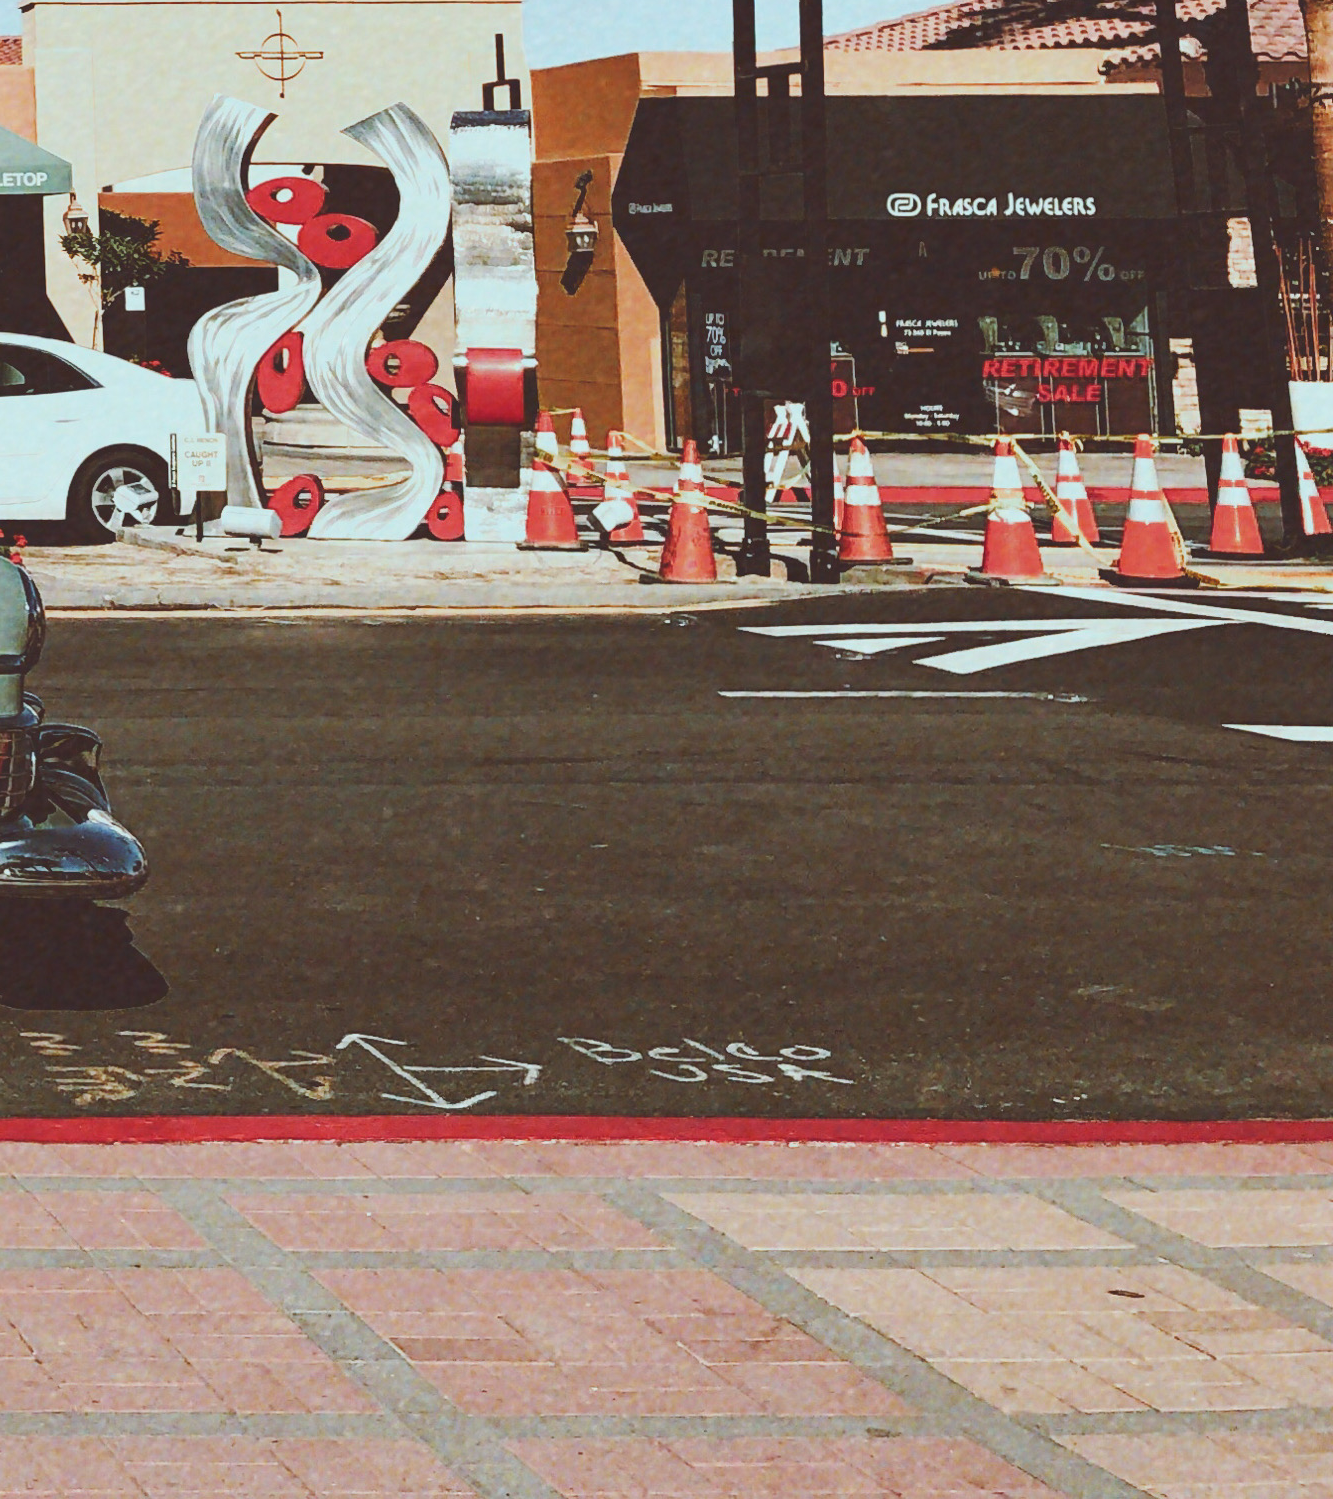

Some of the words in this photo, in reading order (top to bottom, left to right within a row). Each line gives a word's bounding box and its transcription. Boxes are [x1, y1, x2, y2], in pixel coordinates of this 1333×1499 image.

[1013, 246, 1115, 282] 70%
[1119, 270, 1145, 281] OFF
[982, 357, 1155, 378] RETIREMENT
[1036, 384, 1103, 403] SALE
[184, 451, 219, 459] CAUGHT
